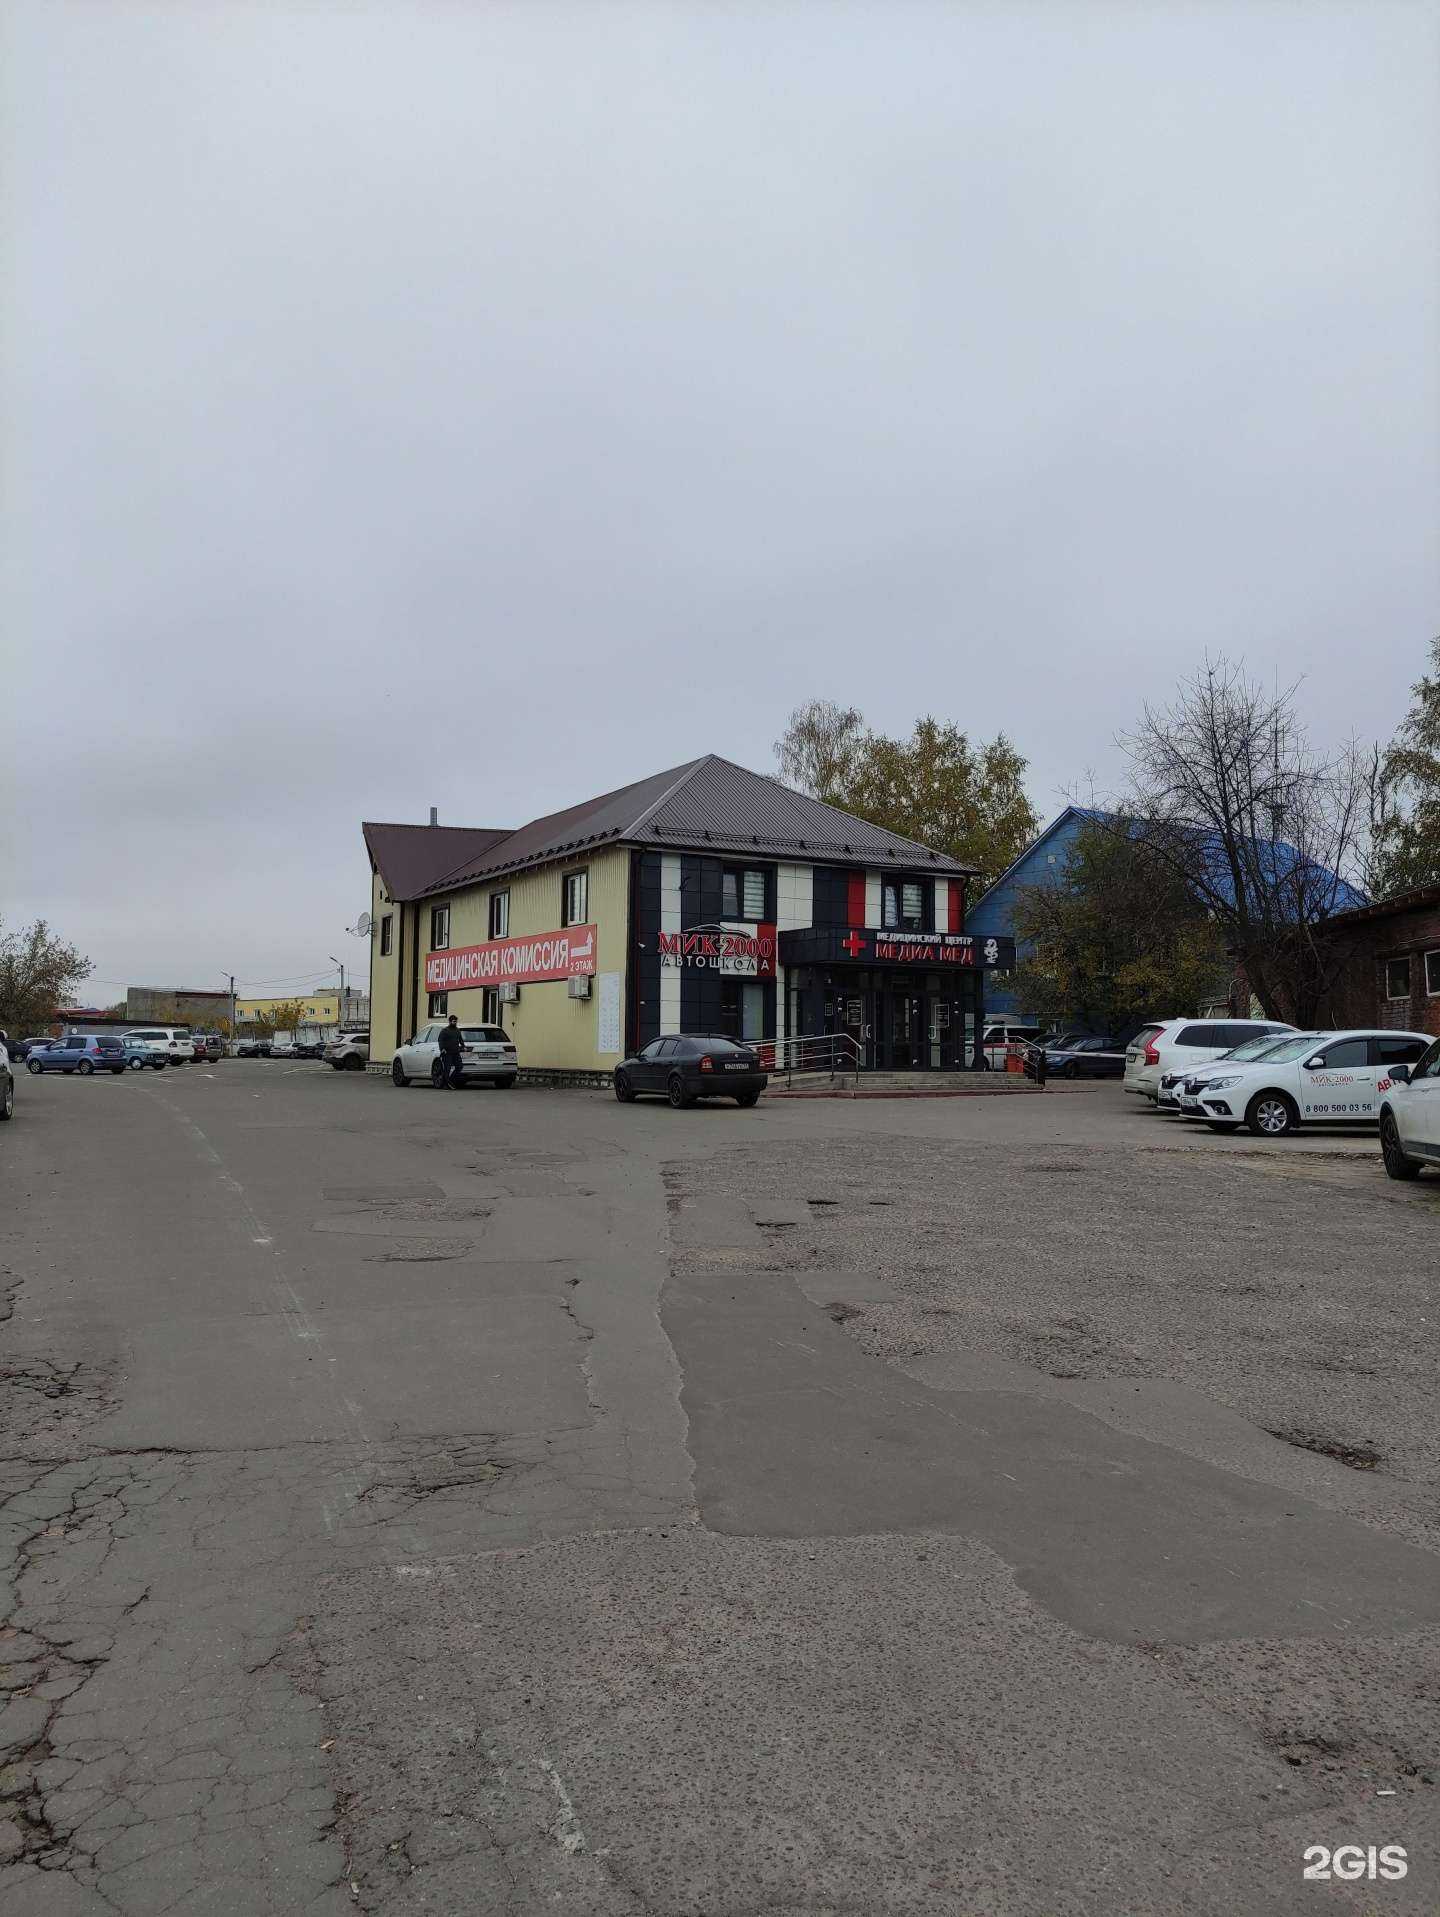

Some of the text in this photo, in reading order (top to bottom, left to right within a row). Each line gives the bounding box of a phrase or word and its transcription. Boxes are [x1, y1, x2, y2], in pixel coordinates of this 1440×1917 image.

[657, 931, 773, 958] МИК-2000
[876, 932, 974, 946] МЕДИЦИНСКИЙ ЦЕНТР
[875, 943, 976, 965] МЕДИА МЕД
[427, 938, 569, 986] МЕДИЦИНСКАЯ КОМИССИЯ
[575, 959, 593, 971] ЭТАЖ
[661, 955, 770, 971] АВТОШКОЛА
[1310, 1074, 1354, 1084] МИК-2000
[1305, 1105, 1311, 1113] 8
[1313, 1104, 1329, 1113] 800
[1331, 1104, 1347, 1112] 500
[1349, 1103, 1360, 1112] 03
